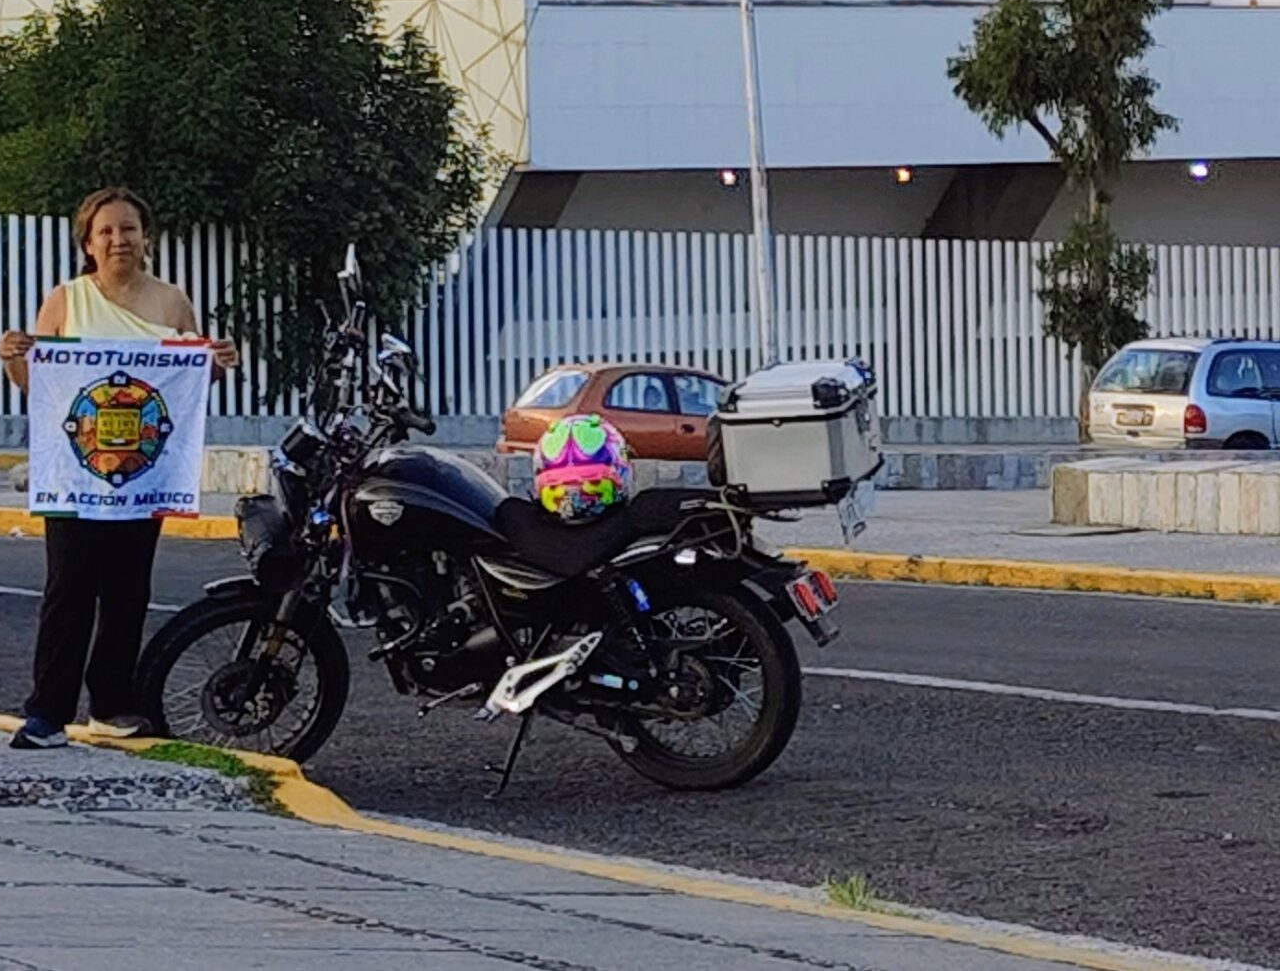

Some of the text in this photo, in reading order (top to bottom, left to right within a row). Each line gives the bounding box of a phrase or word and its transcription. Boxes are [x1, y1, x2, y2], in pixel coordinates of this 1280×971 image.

[32, 348, 208, 368] MOTOTURISMO
[35, 488, 195, 506] EN ACCIÓN MÉXICO
